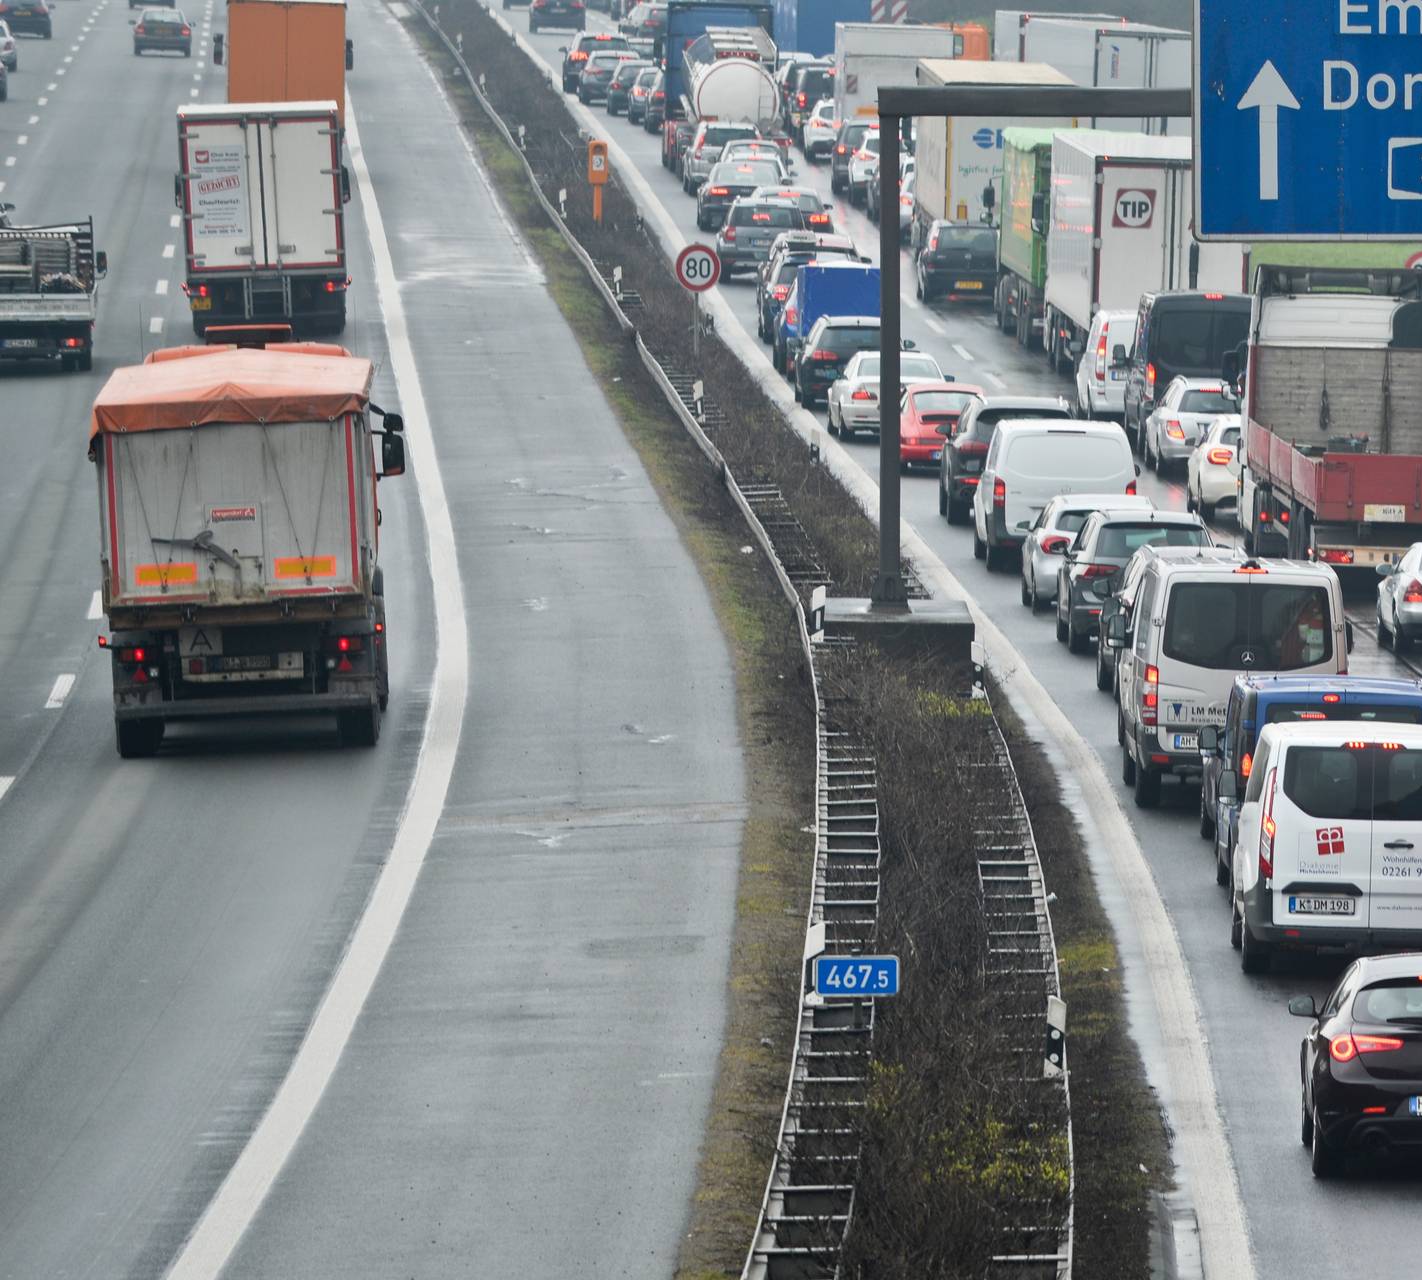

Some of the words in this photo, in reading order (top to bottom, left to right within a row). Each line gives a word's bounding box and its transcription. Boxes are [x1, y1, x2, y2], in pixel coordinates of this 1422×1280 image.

[1119, 201, 1150, 218] TIP
[684, 257, 711, 279] 80
[190, 629, 213, 651] A
[1191, 706, 1205, 716] LM
[1382, 855, 1422, 864] Wohnhilfen
[1382, 867, 1411, 877] 02261
[1299, 898, 1306, 910] K
[1313, 898, 1328, 910] DM
[1331, 898, 1349, 911] 198
